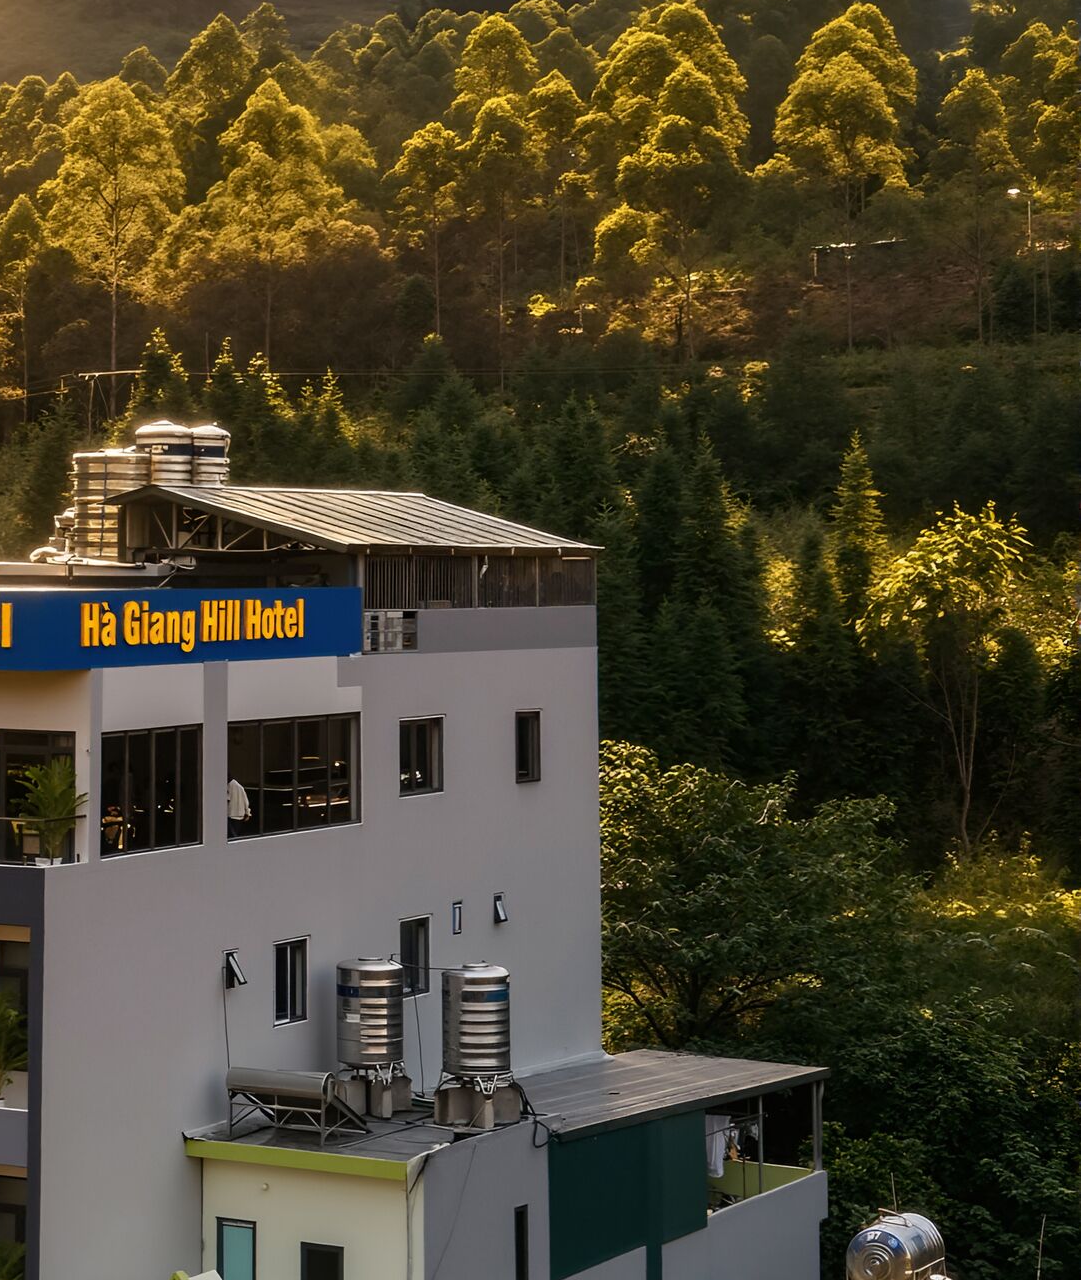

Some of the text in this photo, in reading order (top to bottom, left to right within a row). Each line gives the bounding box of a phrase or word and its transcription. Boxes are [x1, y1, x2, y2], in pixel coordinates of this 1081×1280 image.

[80, 598, 305, 653] Hà Giang Hill Hotel
